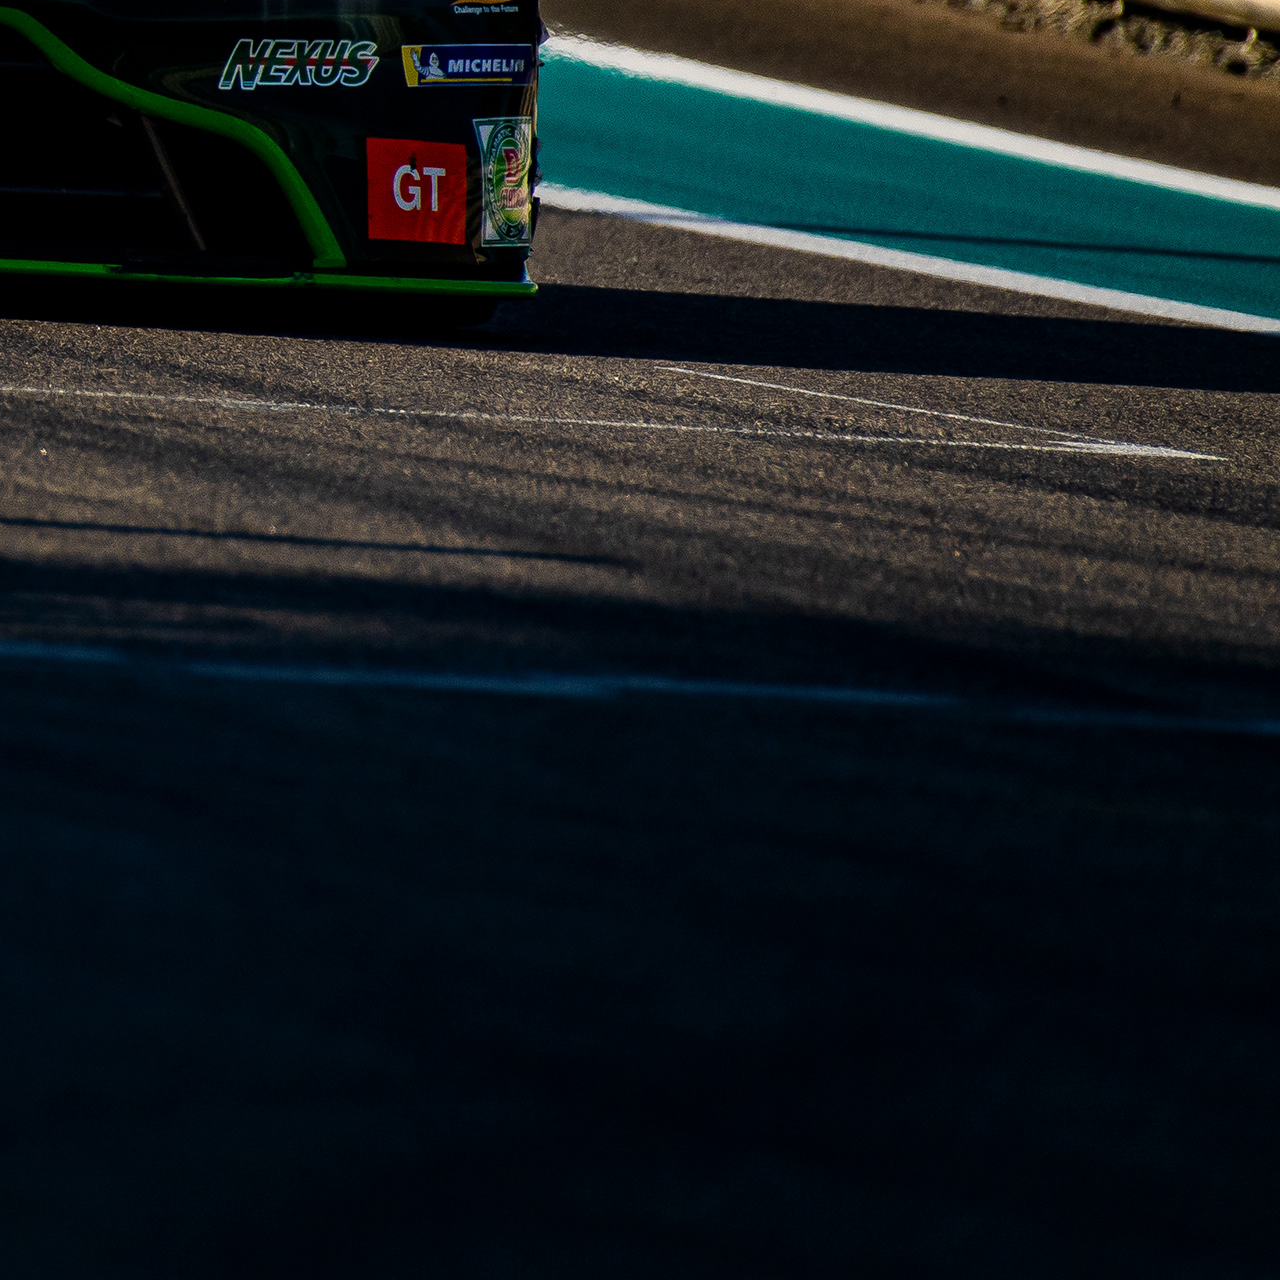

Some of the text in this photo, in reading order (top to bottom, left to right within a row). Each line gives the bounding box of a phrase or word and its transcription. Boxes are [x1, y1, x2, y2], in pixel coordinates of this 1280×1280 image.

[454, 6, 482, 15] Challenge
[218, 39, 380, 91] NEXUS
[448, 59, 525, 73] MICHELIN
[393, 164, 446, 212] GT
